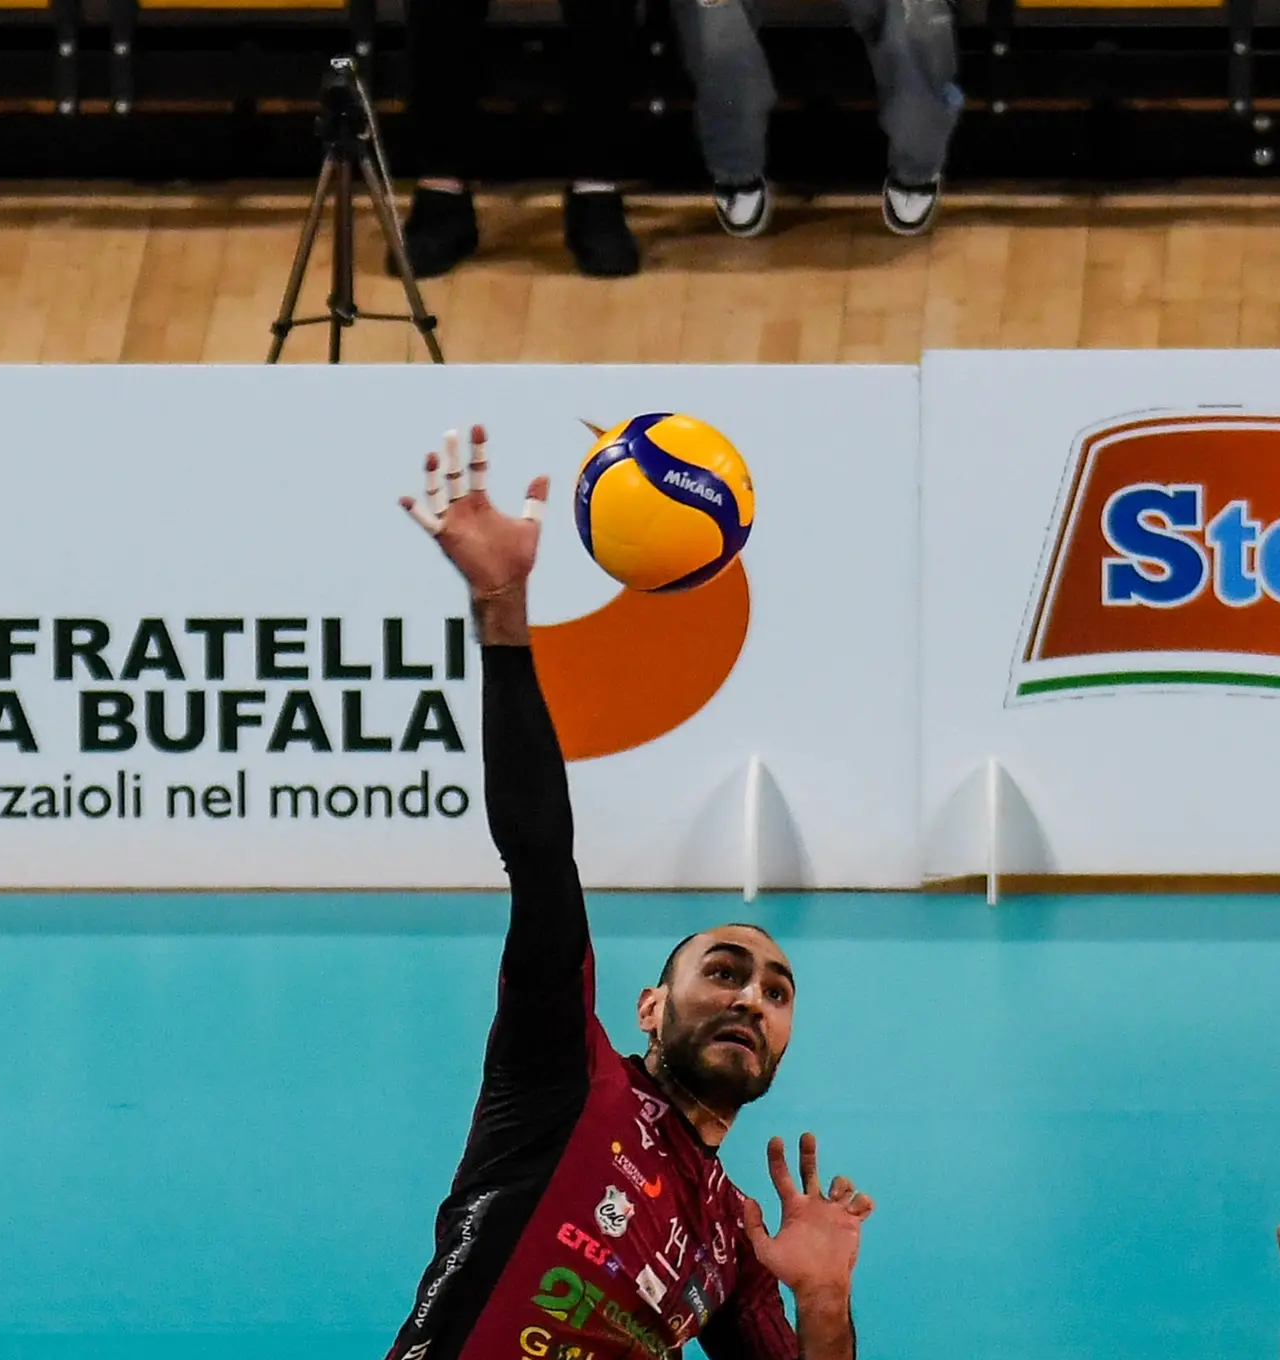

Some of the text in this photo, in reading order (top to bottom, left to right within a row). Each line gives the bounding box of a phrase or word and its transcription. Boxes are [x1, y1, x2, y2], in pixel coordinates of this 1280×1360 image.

[80, 689, 466, 754] BUFALA
[166, 769, 245, 821] nel
[269, 769, 470, 821] mondo
